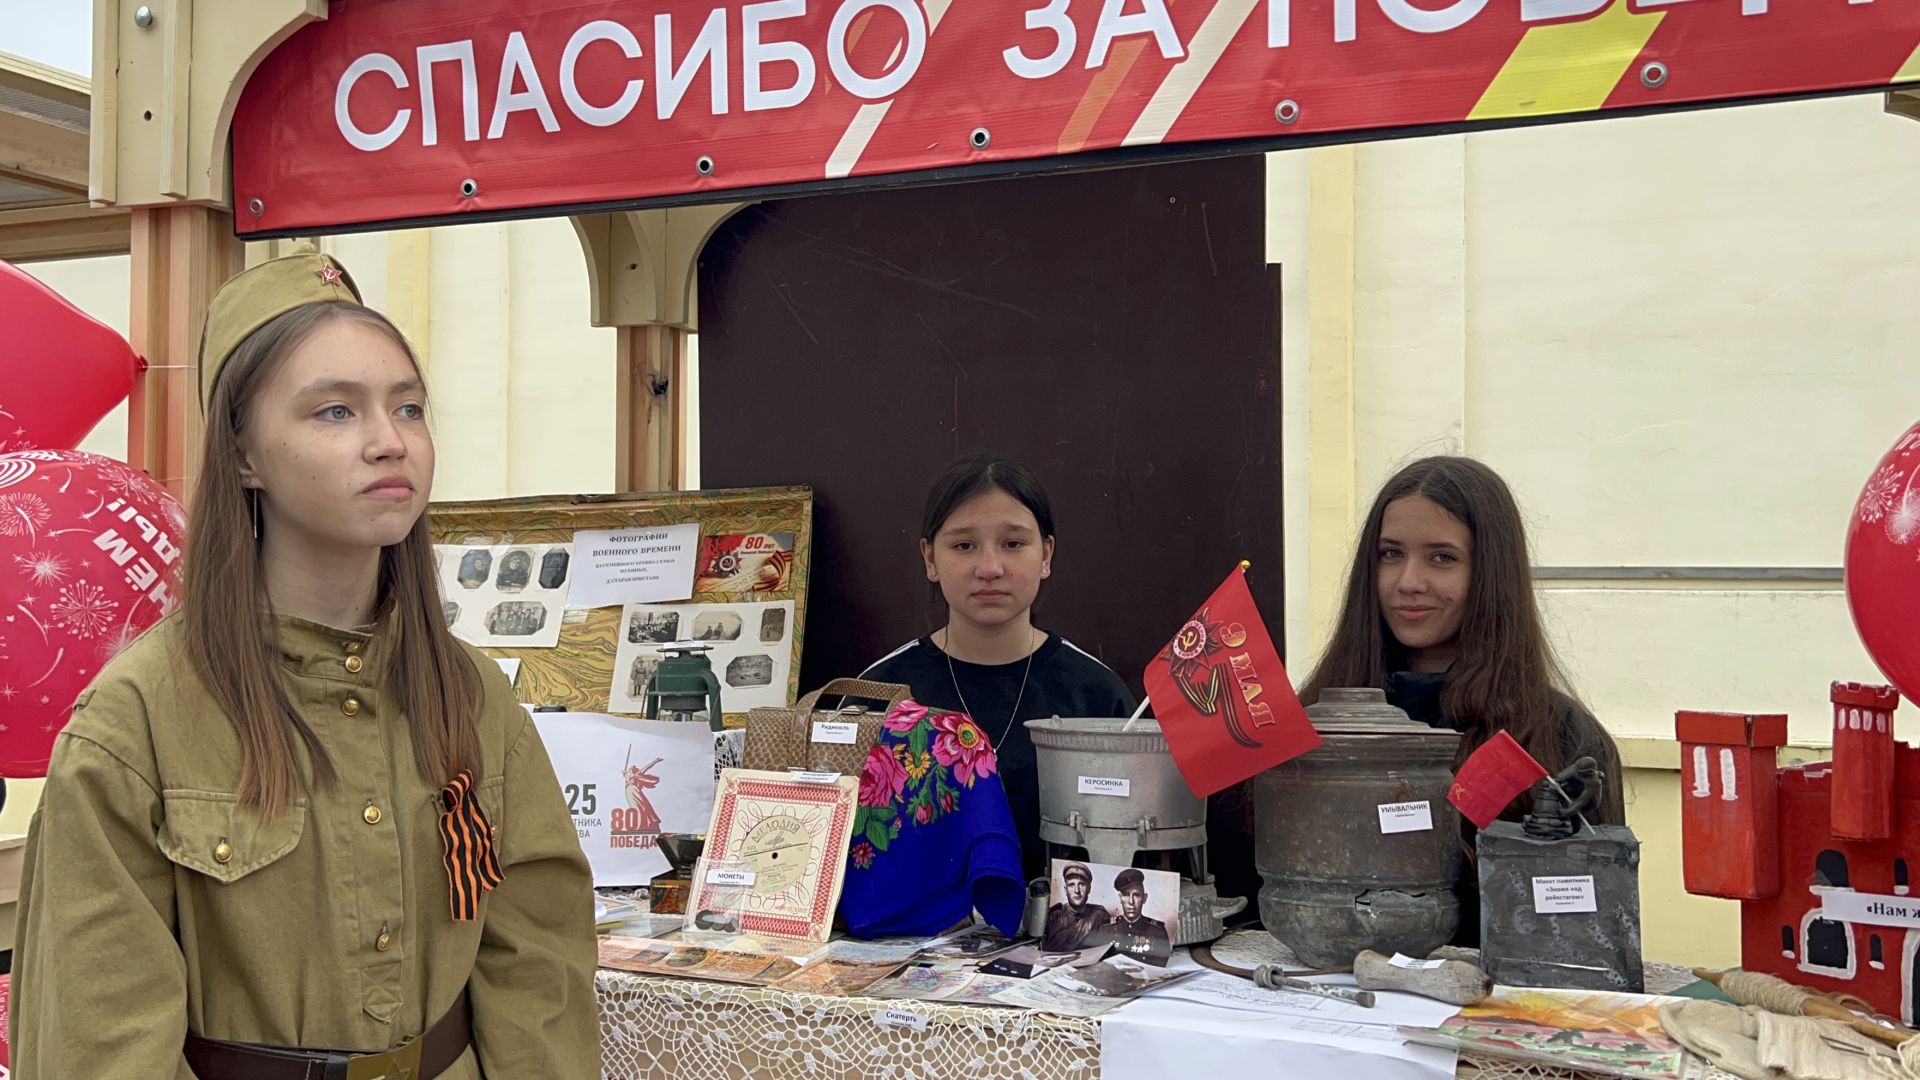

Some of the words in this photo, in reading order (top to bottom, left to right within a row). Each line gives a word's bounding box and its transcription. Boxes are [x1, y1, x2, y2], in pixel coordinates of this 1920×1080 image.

[335, 0, 927, 152] СПАСИБО
[1001, 0, 1188, 79] ЗА
[609, 533, 668, 543] ФОТОГРАФИИ
[745, 536, 764, 549] 80
[592, 548, 638, 557] ВОЕННОГО
[640, 545, 681, 554] ВРЕМЕНИ
[93, 528, 178, 618] НЁМ
[1220, 622, 1247, 648] 9
[1229, 652, 1276, 728] МАЯ
[1084, 778, 1123, 787] КЕРОСИНКА
[1381, 803, 1428, 813] УМЫВАЛЬНИК
[574, 818, 602, 827] ТНИКА
[610, 808, 639, 831] 80
[751, 819, 801, 843] МЕЛОДИЯ
[1866, 902, 1907, 917] «Нам
[886, 1011, 917, 1022] Скатерть
